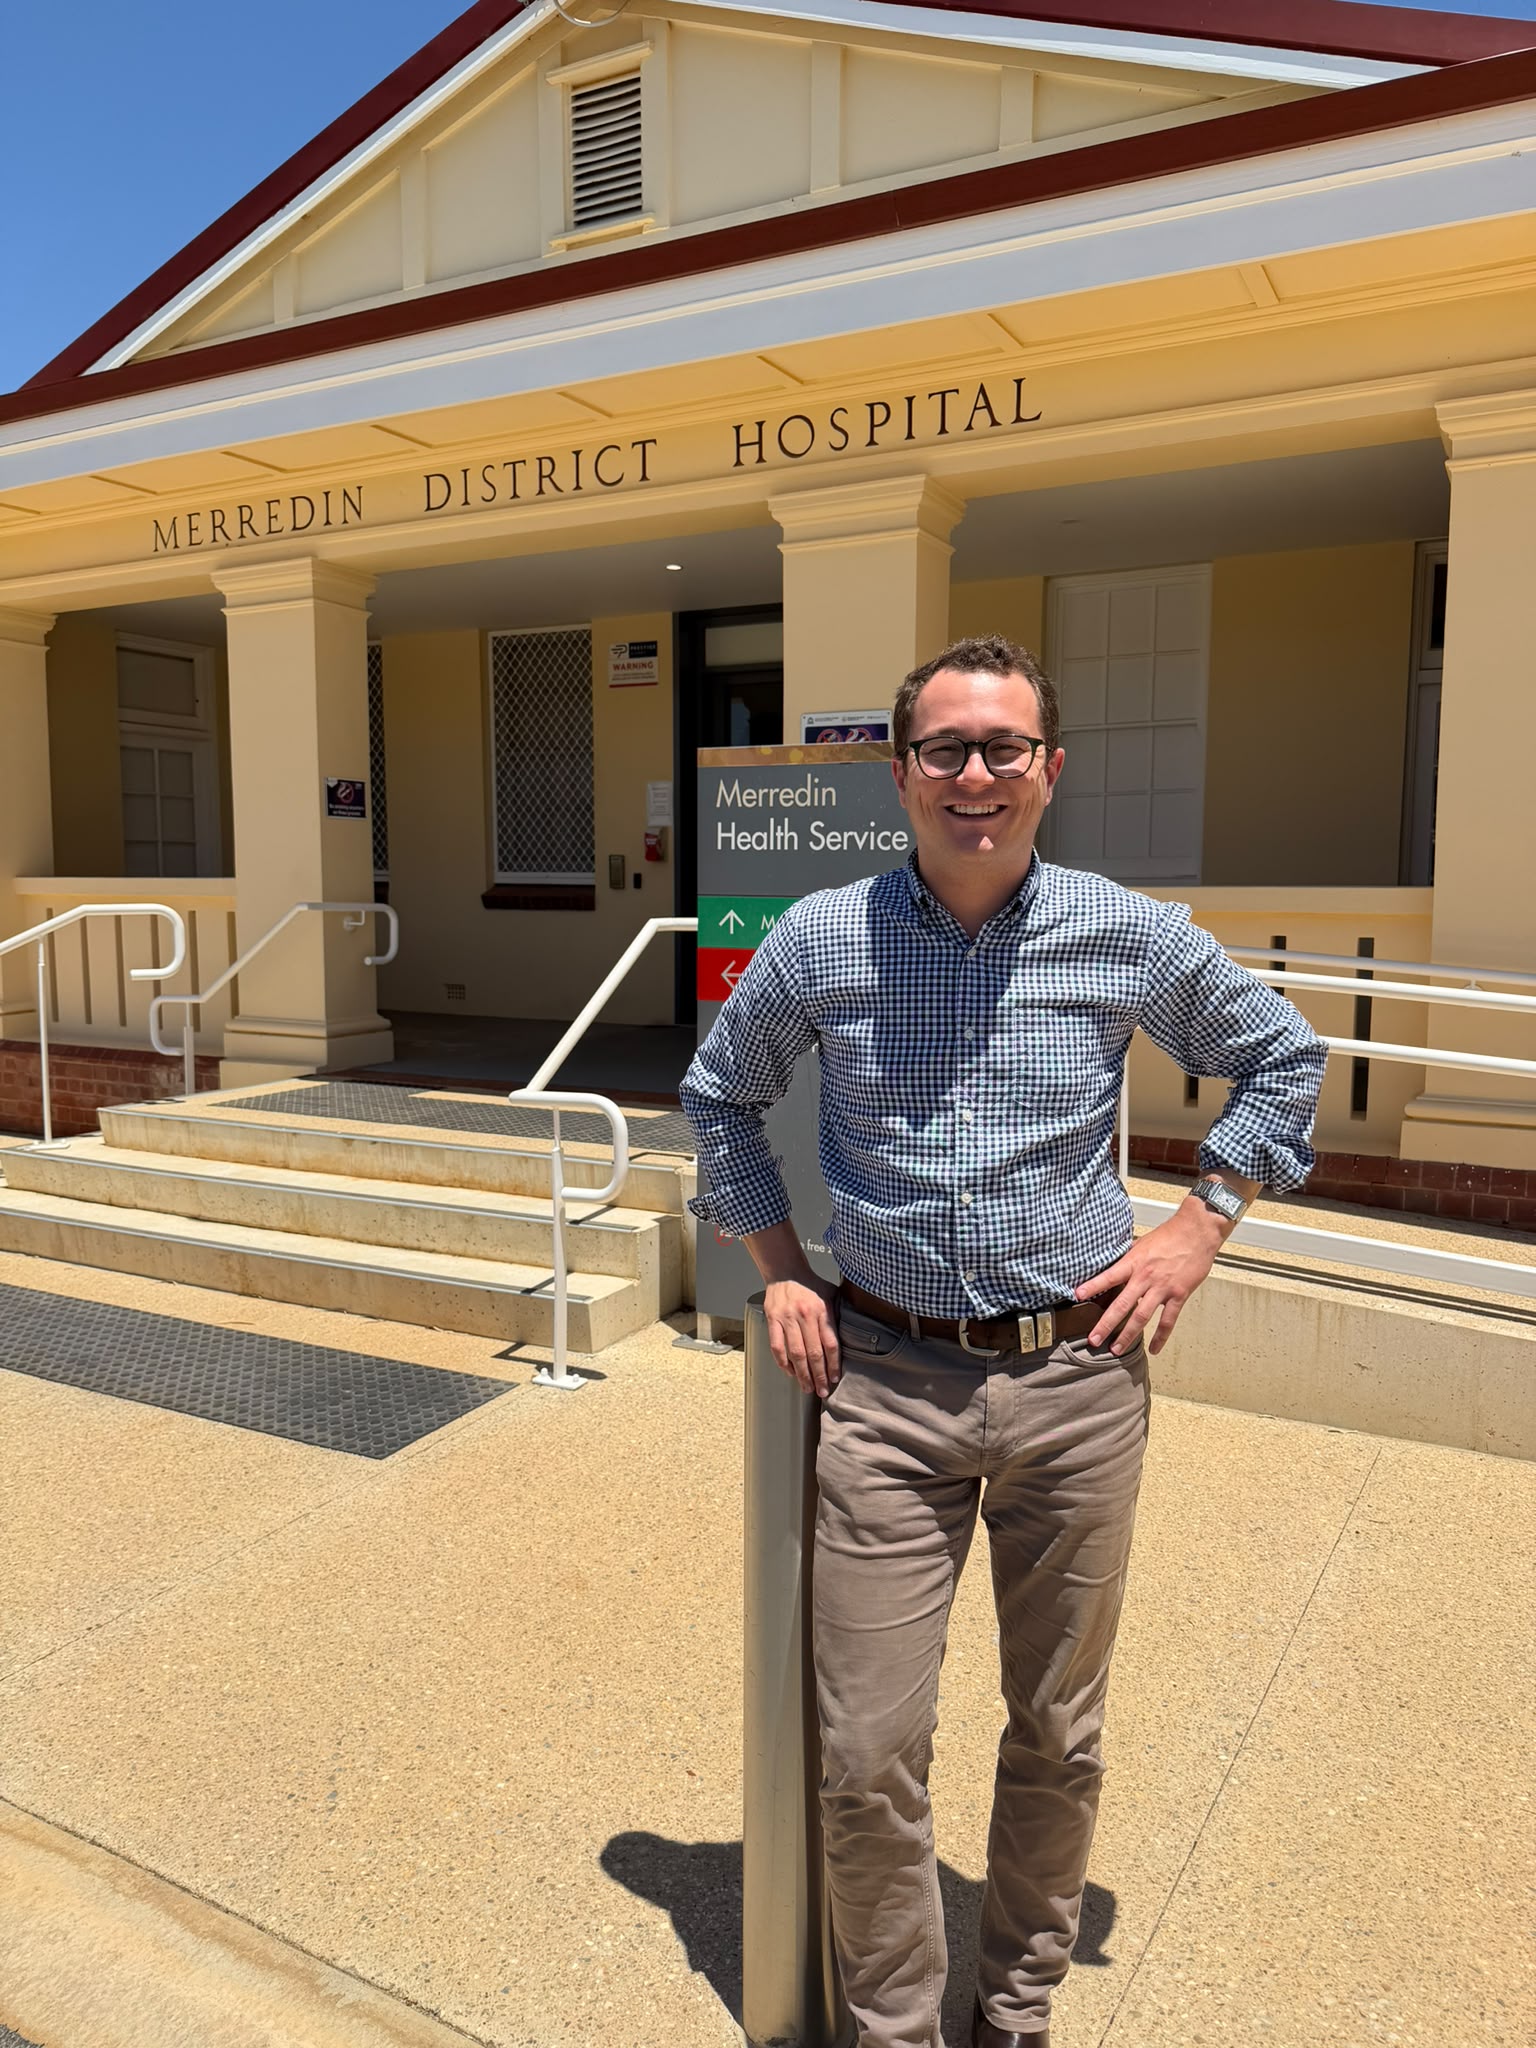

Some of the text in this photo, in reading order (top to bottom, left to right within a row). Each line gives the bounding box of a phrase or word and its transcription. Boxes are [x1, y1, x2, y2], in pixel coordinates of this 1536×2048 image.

[152, 377, 1043, 553] MERREDIN DISTRICT HOSPITAL
[613, 661, 654, 670] WARNING
[716, 773, 836, 808] Merredin
[717, 817, 909, 851] Health Service
[807, 1238, 825, 1253] free
